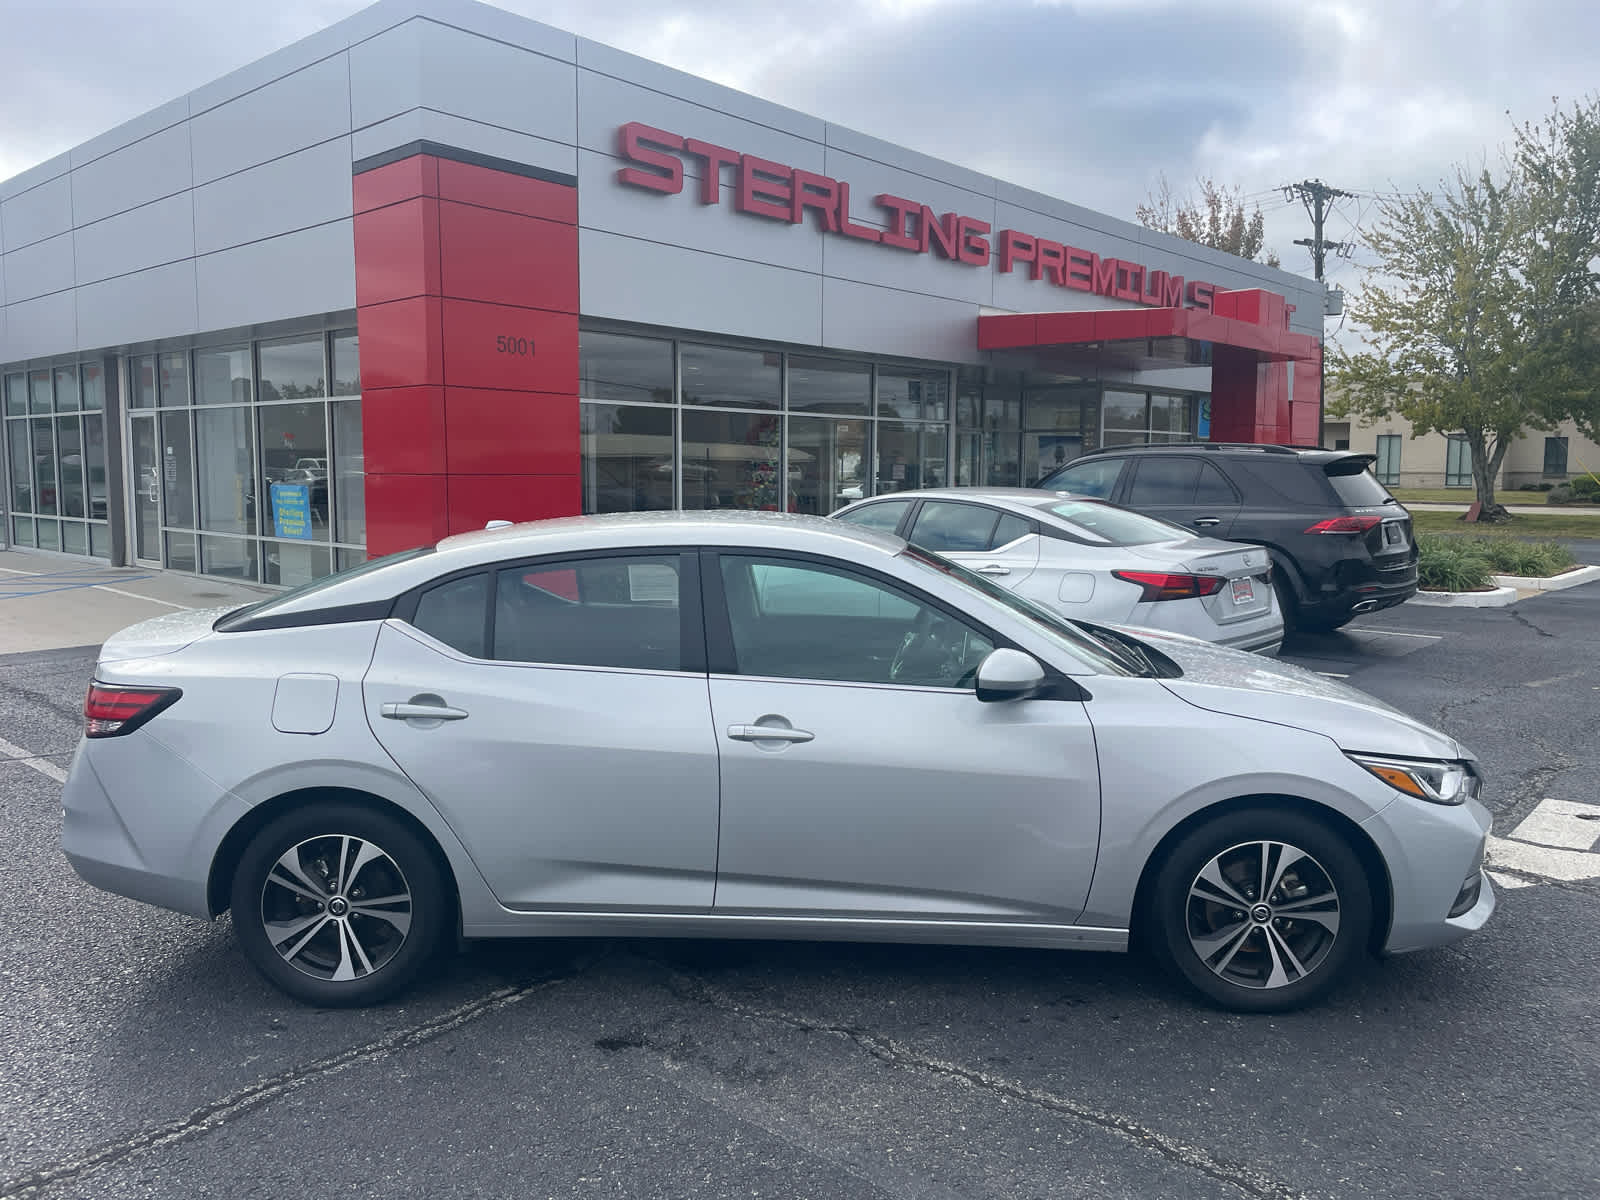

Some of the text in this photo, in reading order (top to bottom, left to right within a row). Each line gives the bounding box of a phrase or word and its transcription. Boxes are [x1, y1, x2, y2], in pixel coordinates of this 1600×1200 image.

[616, 121, 992, 267] STERLING
[999, 229, 1185, 309] PREMIUM
[496, 335, 536, 357] 5001
